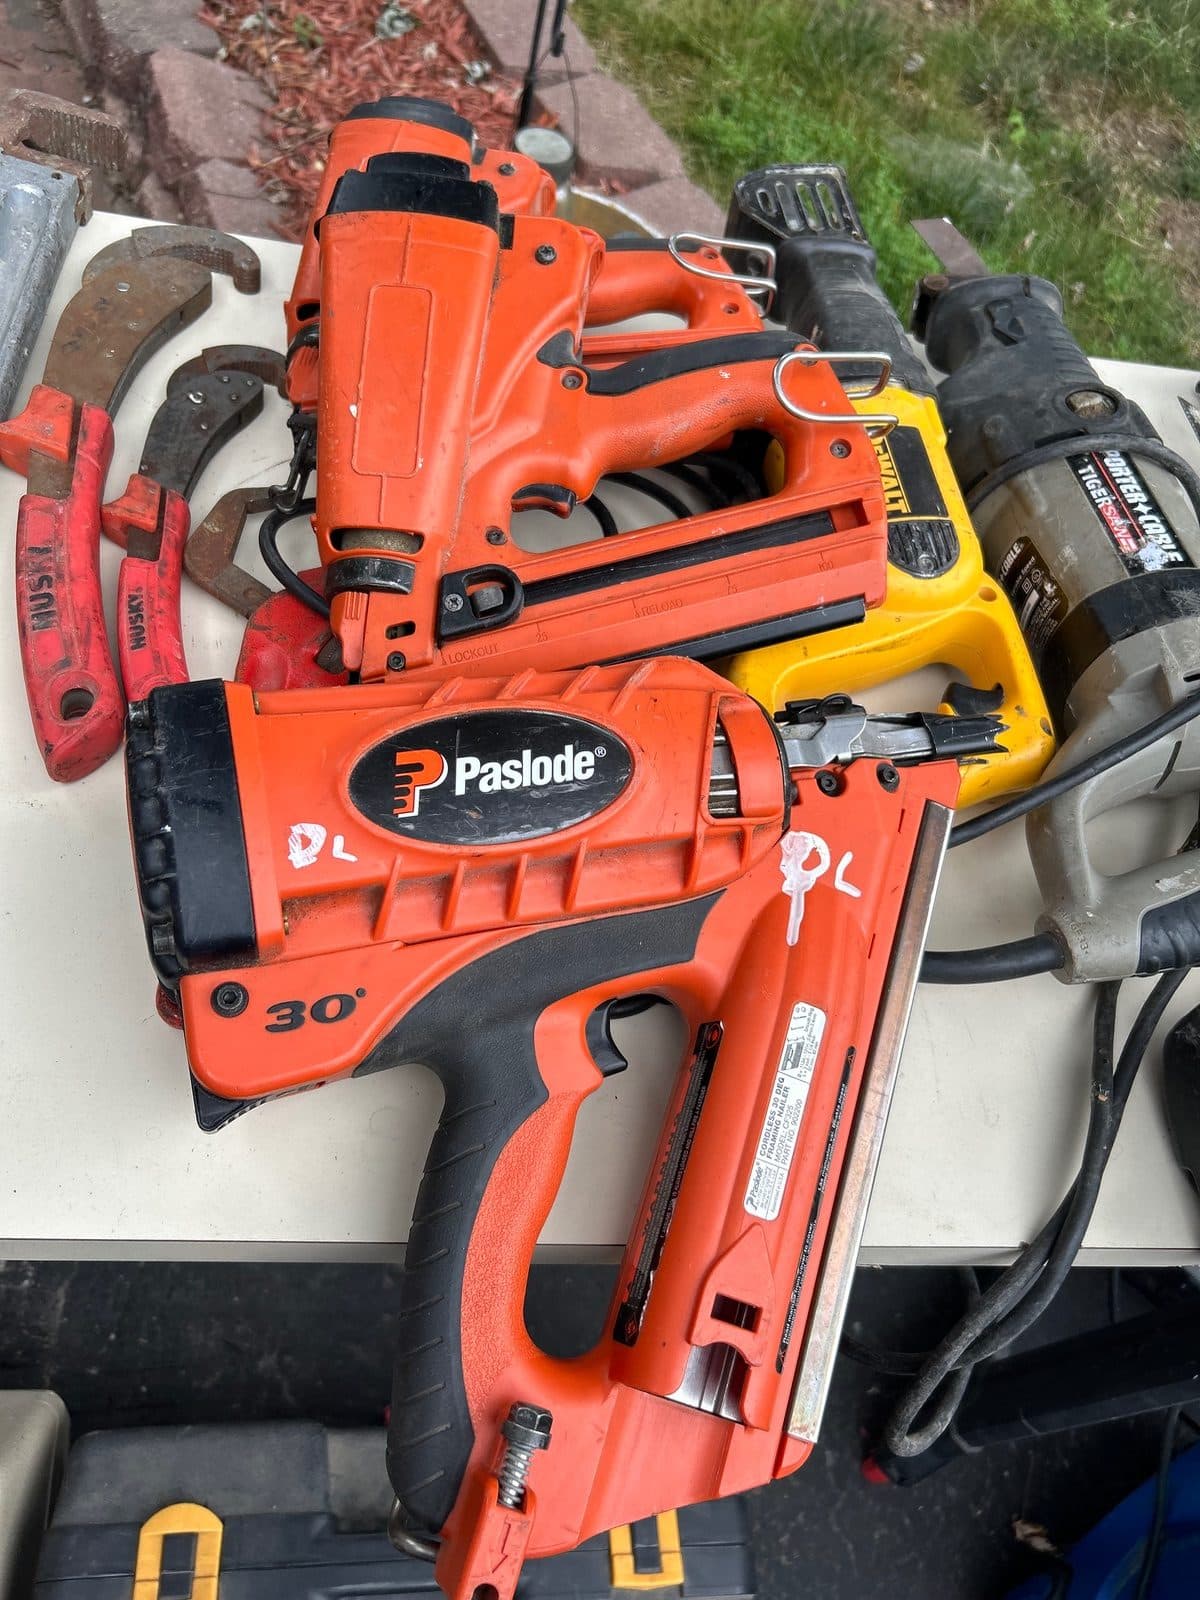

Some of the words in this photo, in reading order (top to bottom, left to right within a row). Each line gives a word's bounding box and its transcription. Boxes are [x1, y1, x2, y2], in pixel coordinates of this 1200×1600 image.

[873, 438, 906, 514] DEWALT
[1103, 450, 1145, 510] PORTER
[27, 546, 57, 631] HUS
[641, 598, 683, 617] RELOAD
[449, 642, 500, 664] LOCKOUT
[771, 1096, 779, 1108] 30
[774, 1076, 785, 1095] DEG
[759, 1109, 776, 1156] CORDLESS
[766, 1119, 781, 1159] FRAMING
[776, 1085, 789, 1117] NAILER
[773, 1129, 787, 1162] MODEL:
[782, 1104, 793, 1129] CF325
[781, 1143, 791, 1165] PART
[790, 1098, 803, 1126] 902200
